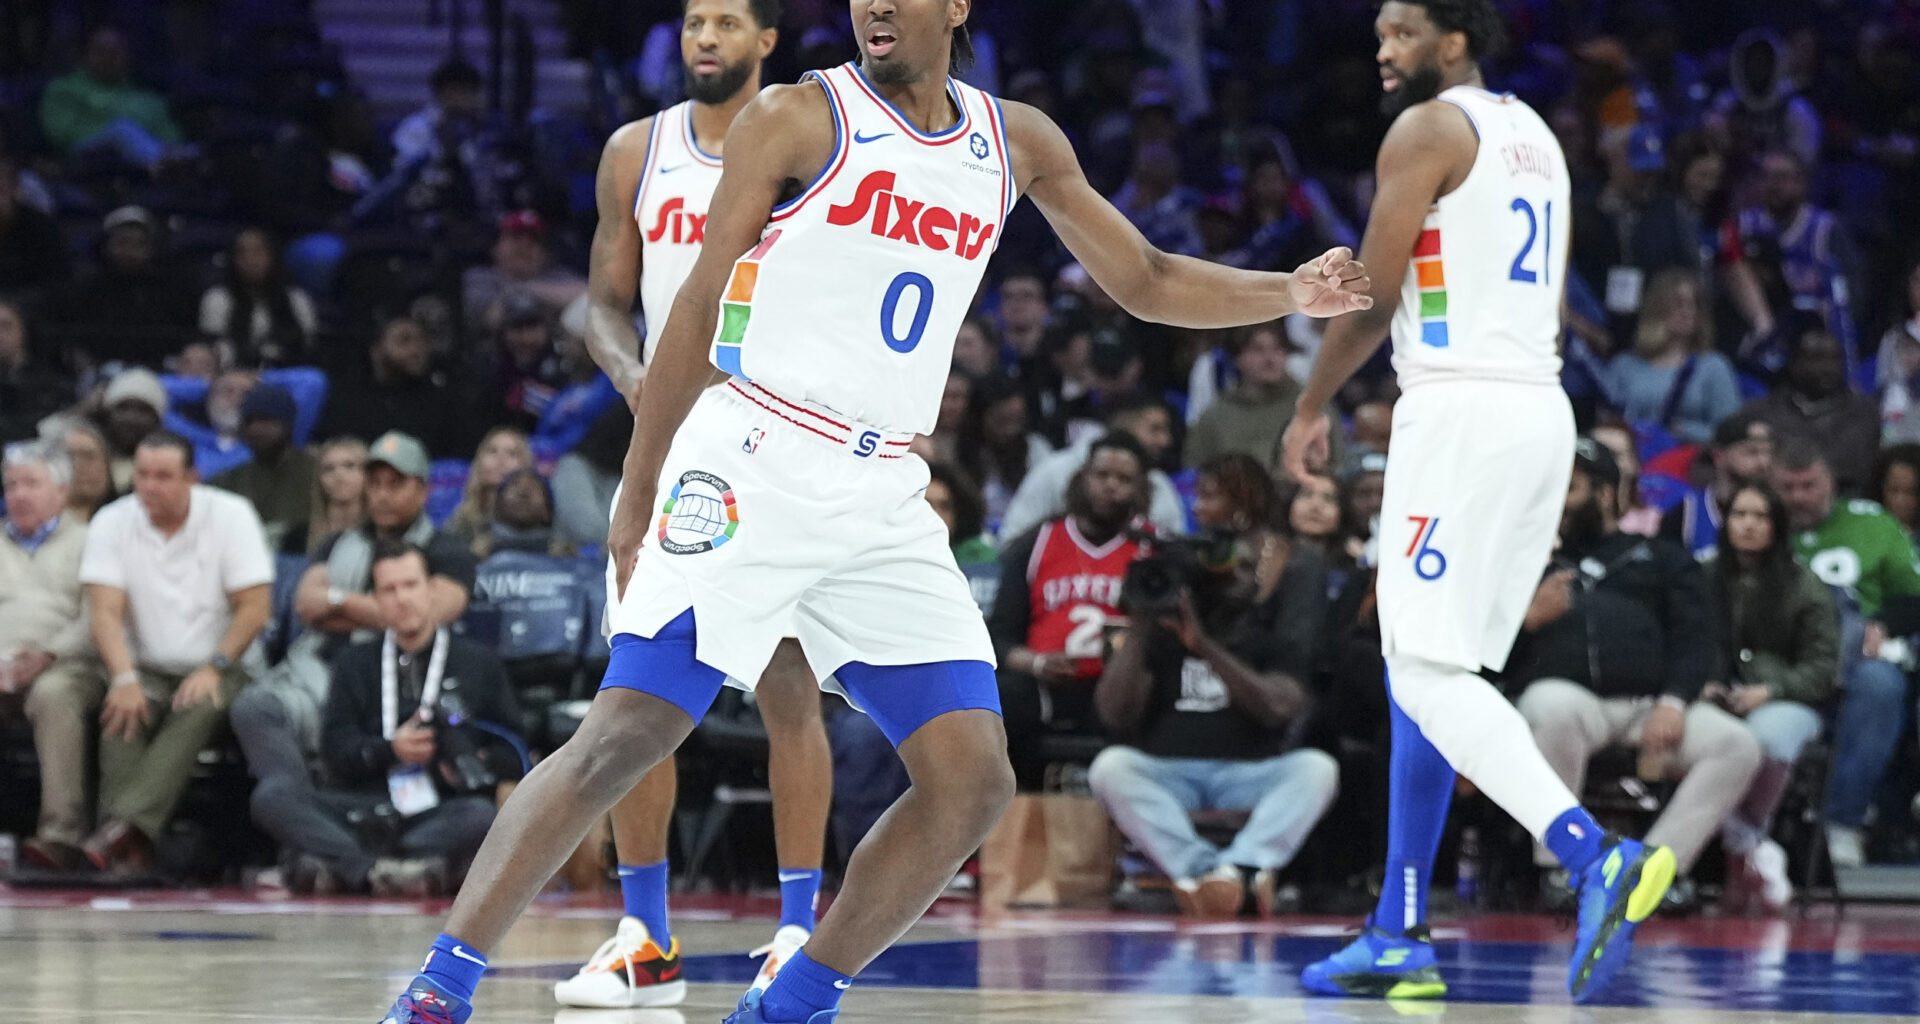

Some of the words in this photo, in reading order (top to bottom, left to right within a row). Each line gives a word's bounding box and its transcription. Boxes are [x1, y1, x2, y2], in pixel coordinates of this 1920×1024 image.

[961, 160, 1001, 177] crypto.com
[647, 196, 708, 245] Six
[826, 169, 995, 261] Sixers
[1509, 197, 1552, 287] 21
[880, 271, 934, 354] 0
[682, 472, 724, 489] Spectrum
[663, 540, 705, 553] Spectrum
[1405, 515, 1447, 581] 76
